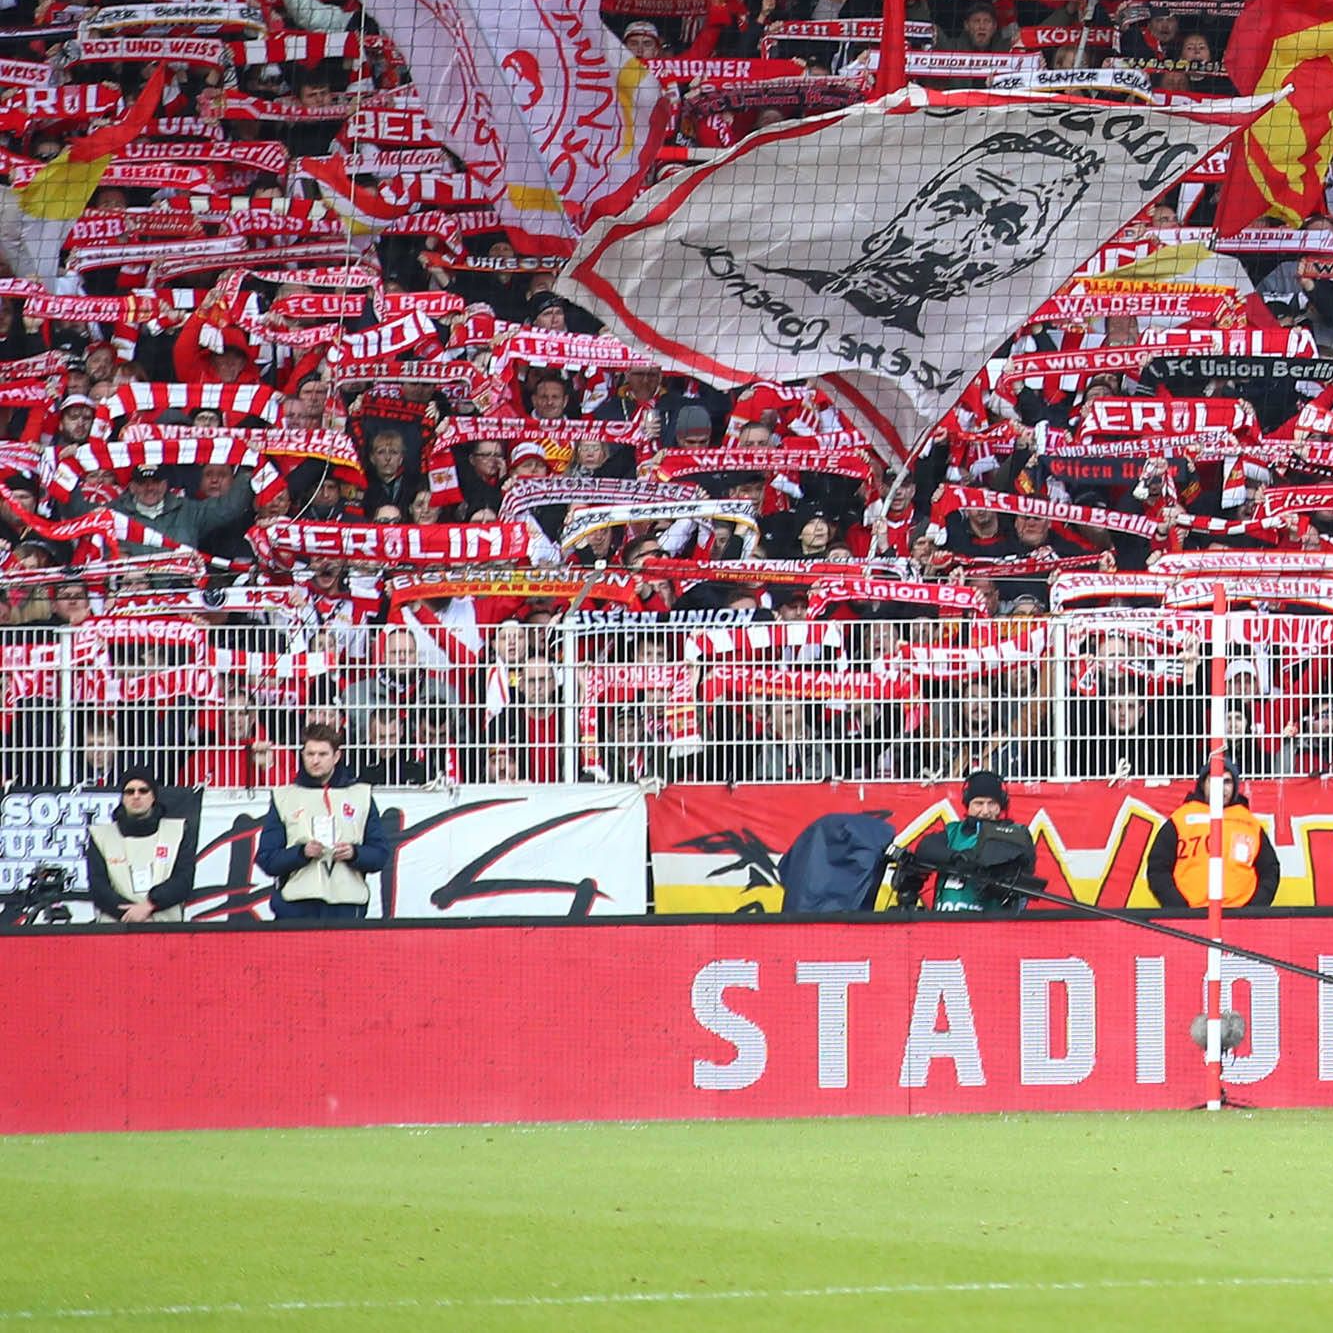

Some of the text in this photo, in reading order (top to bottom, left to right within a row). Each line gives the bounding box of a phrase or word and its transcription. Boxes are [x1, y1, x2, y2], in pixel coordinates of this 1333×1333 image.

[83, 39, 222, 59] ROT UND WEISS
[648, 59, 751, 80] UNIONER
[929, 57, 1008, 68] UNION BERLIN
[124, 136, 288, 166] Union Berlin
[1254, 230, 1295, 242] BERLIN
[287, 298, 317, 314] FC
[1055, 296, 1189, 315] WALDSEITE
[1049, 355, 1090, 372] WIR
[1168, 360, 1195, 378] FC
[1201, 360, 1266, 378] Union
[691, 451, 842, 470] WALDSEITE
[954, 489, 1159, 537] 1. FC Union Berlin
[853, 580, 931, 601] Union
[669, 608, 758, 626] UNION
